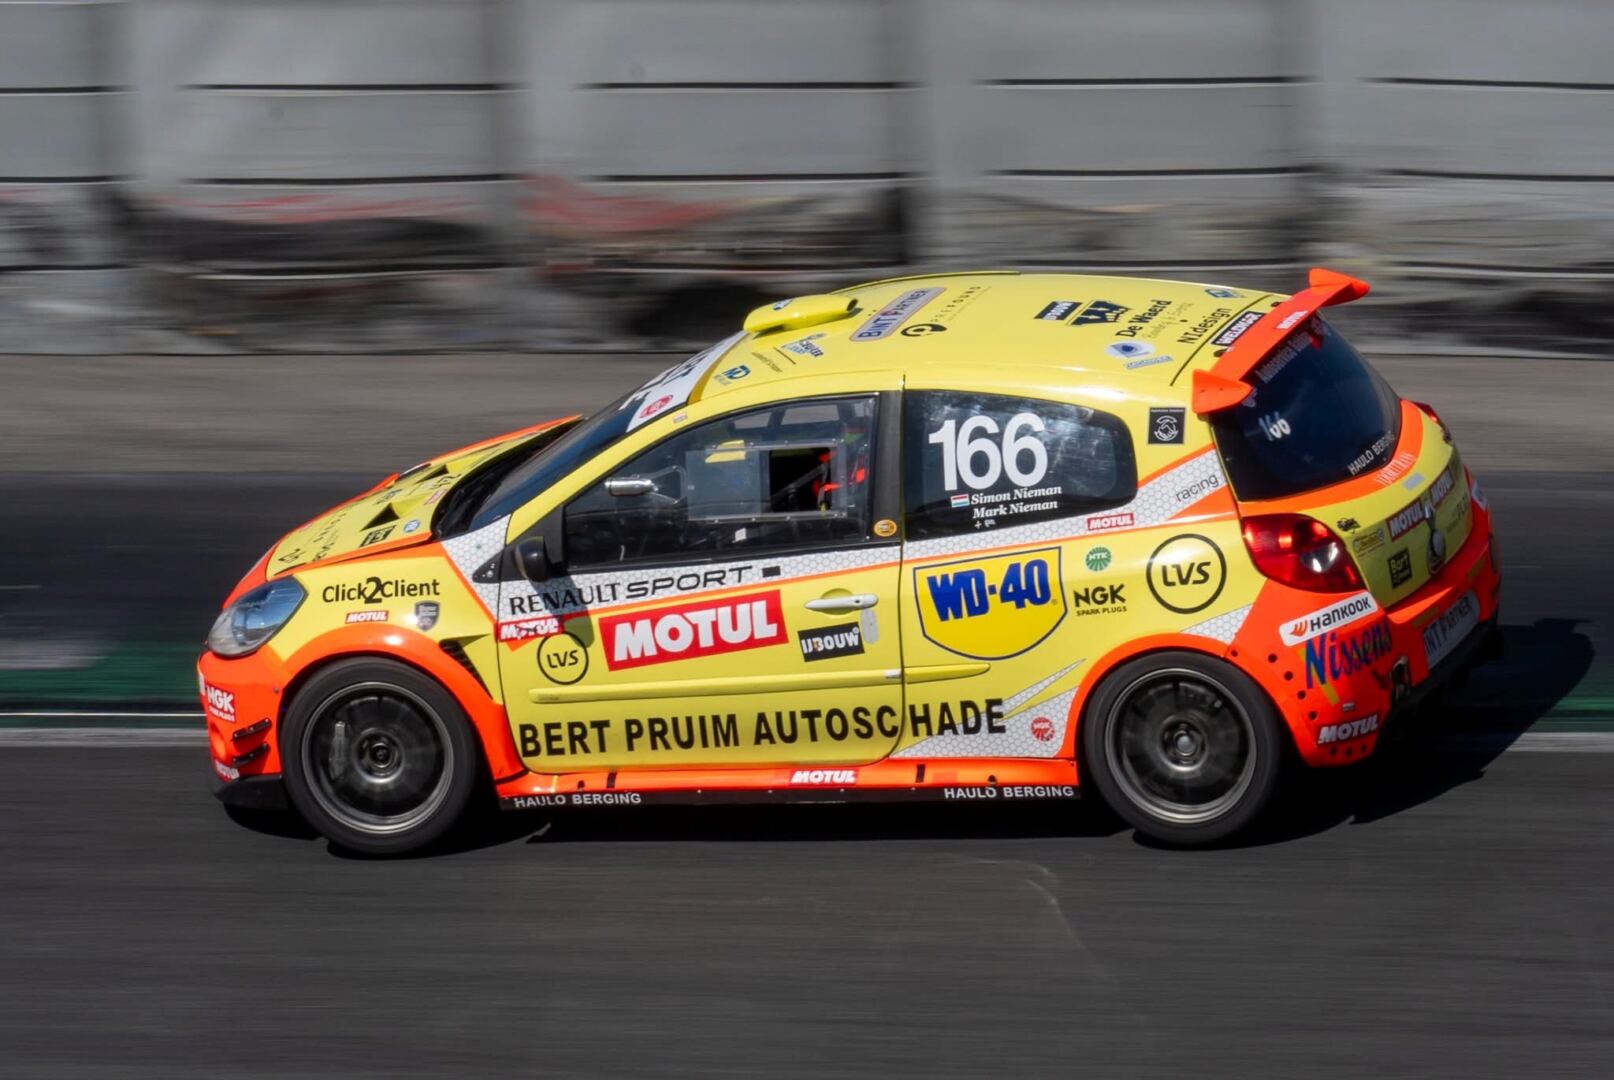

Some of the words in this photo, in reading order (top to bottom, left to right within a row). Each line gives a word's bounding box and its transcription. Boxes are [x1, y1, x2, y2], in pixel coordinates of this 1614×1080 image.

[1116, 323, 1143, 338] De
[1134, 299, 1173, 325] Waerd
[928, 412, 1048, 491] 166
[1347, 450, 1374, 476] HAULO
[971, 490, 1011, 506] Simon
[1013, 485, 1062, 501] Nieman
[1175, 473, 1219, 502] racing
[973, 504, 1007, 519] Mark
[1009, 500, 1058, 515] Nieman
[1088, 515, 1133, 530] MOTUL
[1389, 501, 1424, 538] MOTUL
[1161, 560, 1211, 587] LVS
[322, 576, 441, 604] Click2Client
[510, 582, 620, 615] RENAULT
[626, 566, 753, 599] SPORT
[927, 559, 1051, 622] WD-40
[1074, 584, 1126, 607] NGK
[346, 611, 388, 623] MOTUL
[1076, 607, 1101, 616] SPARK
[1102, 605, 1127, 615] PLUGS
[500, 617, 560, 641] MOTUL
[613, 600, 778, 662] MOTUL
[546, 650, 578, 669] LVS
[1305, 618, 1393, 689] Nissens
[207, 684, 235, 714] NGK
[519, 719, 611, 758] BERT
[624, 713, 740, 752] PRUIM
[754, 698, 1006, 746] AUTOSCHADE
[1318, 714, 1379, 744] MOTUL
[790, 769, 857, 784] MOTUL
[514, 794, 567, 808] HAULO
[572, 792, 642, 806] BERGING
[944, 786, 997, 800] HAULO
[1003, 785, 1074, 799] BERGING
